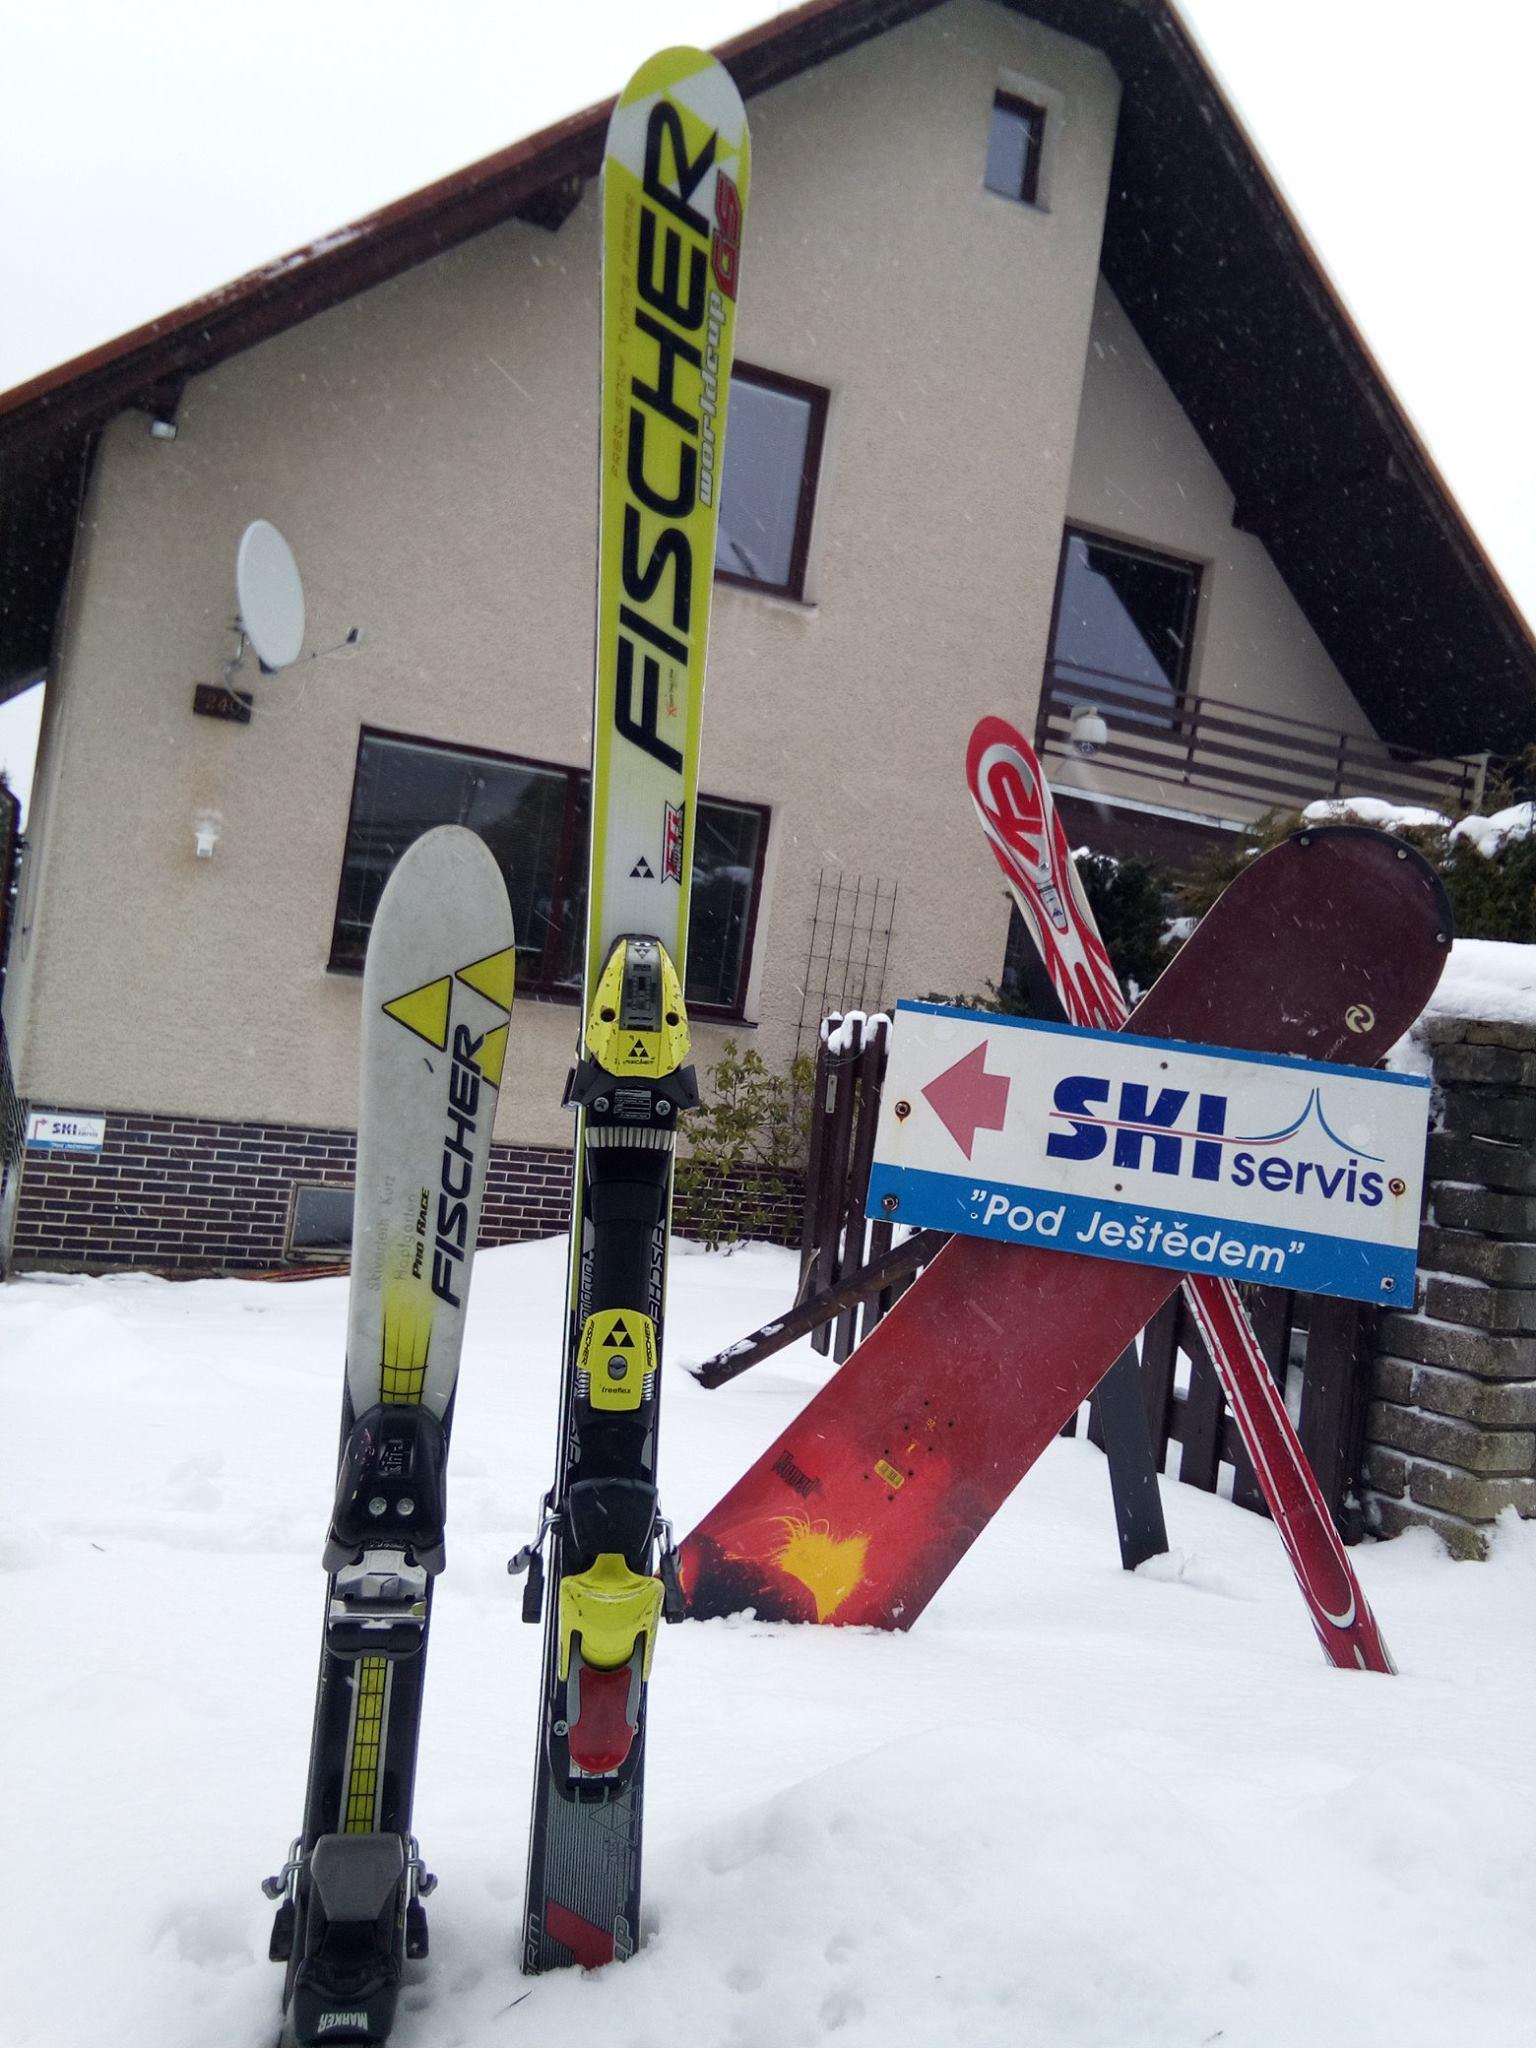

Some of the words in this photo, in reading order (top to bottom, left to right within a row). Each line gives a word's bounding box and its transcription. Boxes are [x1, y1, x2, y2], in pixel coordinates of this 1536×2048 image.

[711, 168, 743, 303] GS
[615, 101, 718, 775] FISCHER
[700, 291, 726, 508] worldcup
[52, 1122, 77, 1136] SKI
[431, 1024, 486, 1308] FISCHER
[1046, 1075, 1227, 1182] SKI
[1231, 1151, 1384, 1207] servis
[581, 1320, 596, 1367] FISCHER
[648, 1226, 665, 1330] FISCHE
[317, 2011, 369, 2034] MARKER
